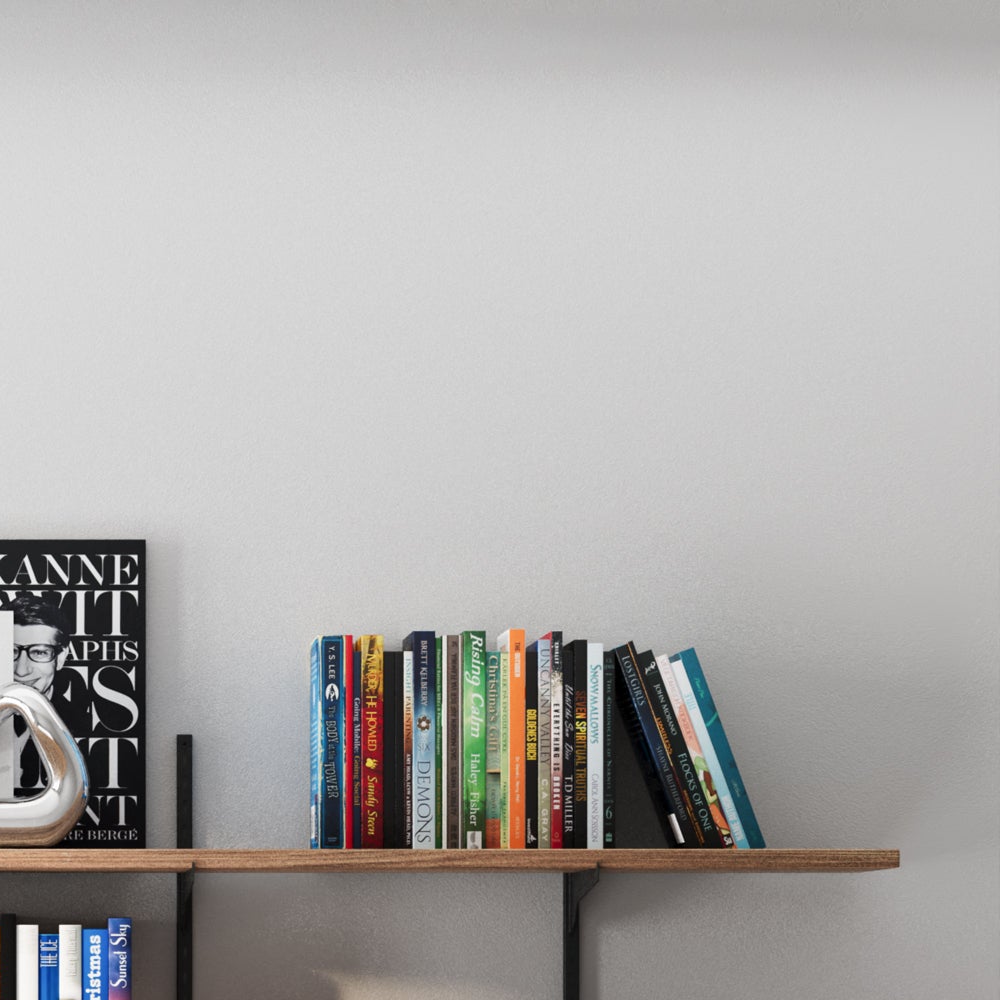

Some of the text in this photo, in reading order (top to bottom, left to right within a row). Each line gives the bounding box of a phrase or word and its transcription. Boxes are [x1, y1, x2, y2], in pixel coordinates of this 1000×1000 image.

[328, 654, 336, 662] S.
[328, 664, 336, 679] LEE
[420, 640, 428, 706] BRETT KELBERRY
[465, 634, 484, 738] Rising Calm
[488, 655, 499, 722] Christina's
[540, 648, 550, 716] UNCANNY
[526, 709, 536, 760] GOLDENES BUCH
[590, 664, 602, 744] SNOWMALLOWS
[653, 684, 677, 735] JOHN MORANO
[324, 720, 340, 798] BODY TOWER
[366, 695, 378, 836] HE HOWLED Sandy Steen
[540, 722, 550, 766] VALLEY
[553, 762, 560, 772] IS
[576, 691, 587, 801] SEVEN SPIRITUAL TRUTHS
[415, 761, 433, 844] DEMONS
[468, 754, 480, 826] Haley Fisher
[564, 795, 573, 832] MILLER
[605, 806, 612, 819] 6
[666, 774, 688, 821] RUTHERFORD
[678, 753, 698, 790] FLOCKS
[693, 792, 703, 807] OF
[699, 809, 713, 831] ONE
[88, 828, 138, 840] BERGÉ
[40, 940, 58, 968] THE ICE
[110, 924, 129, 988] Sunset Sky
